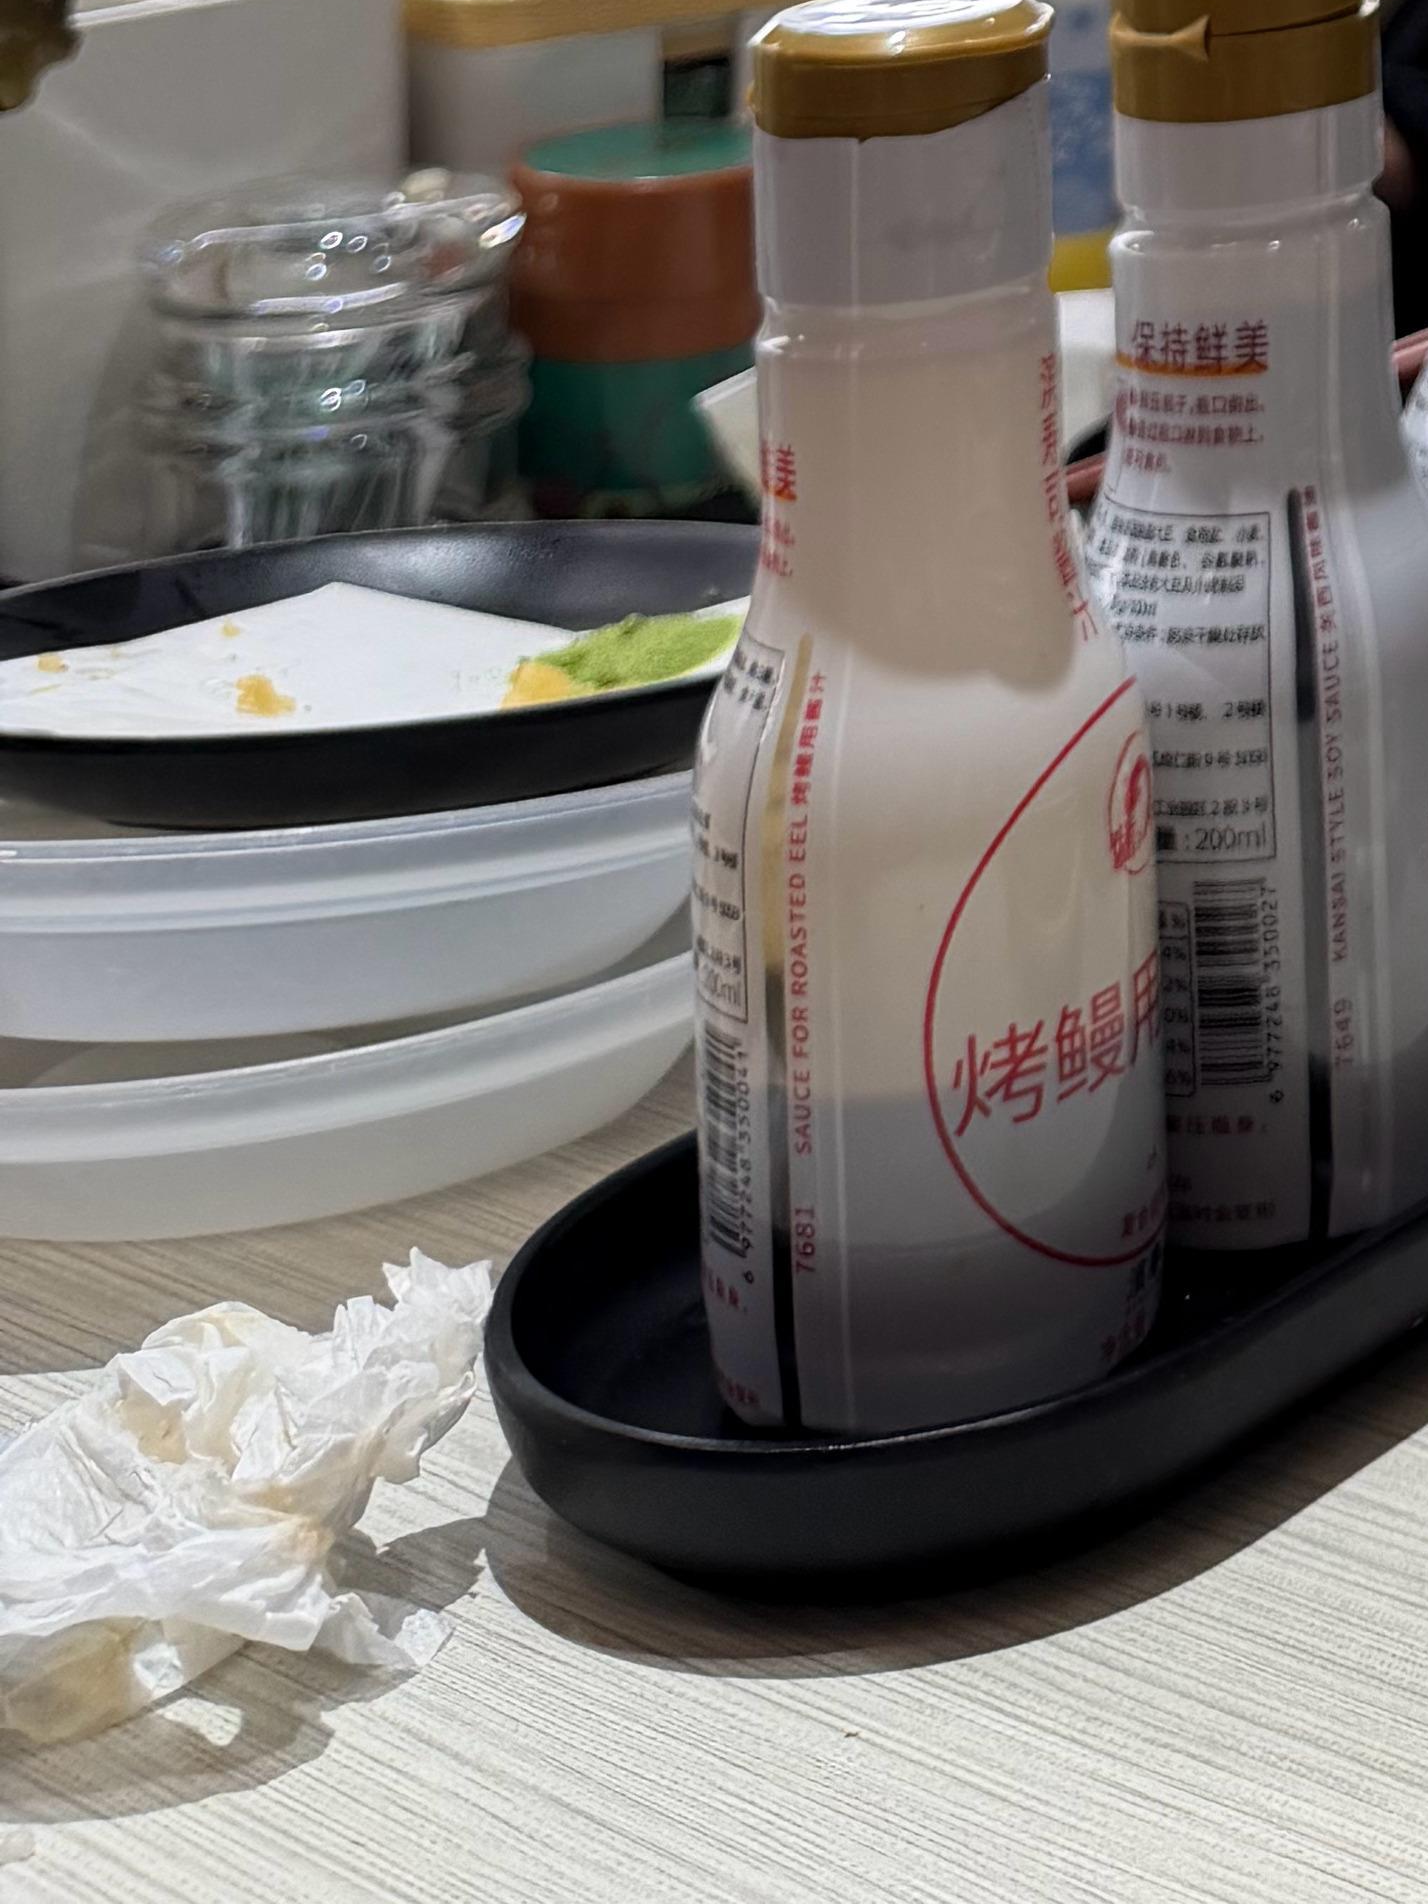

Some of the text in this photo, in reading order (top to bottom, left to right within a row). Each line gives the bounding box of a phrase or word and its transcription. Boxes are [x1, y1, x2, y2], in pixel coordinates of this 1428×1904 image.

[1131, 319, 1270, 371] 保持鲜美
[1322, 639, 1343, 724] SAUCE
[1326, 733, 1344, 782] SOY
[787, 813, 808, 860] EEL
[1328, 788, 1345, 863] STYLE
[788, 877, 810, 996] ROASTED
[1331, 872, 1347, 962] KANSAI
[791, 1005, 810, 1061] FOR
[793, 1069, 812, 1155] SAUCE
[795, 1207, 816, 1273] 7681
[741, 1269, 756, 1285] 6
